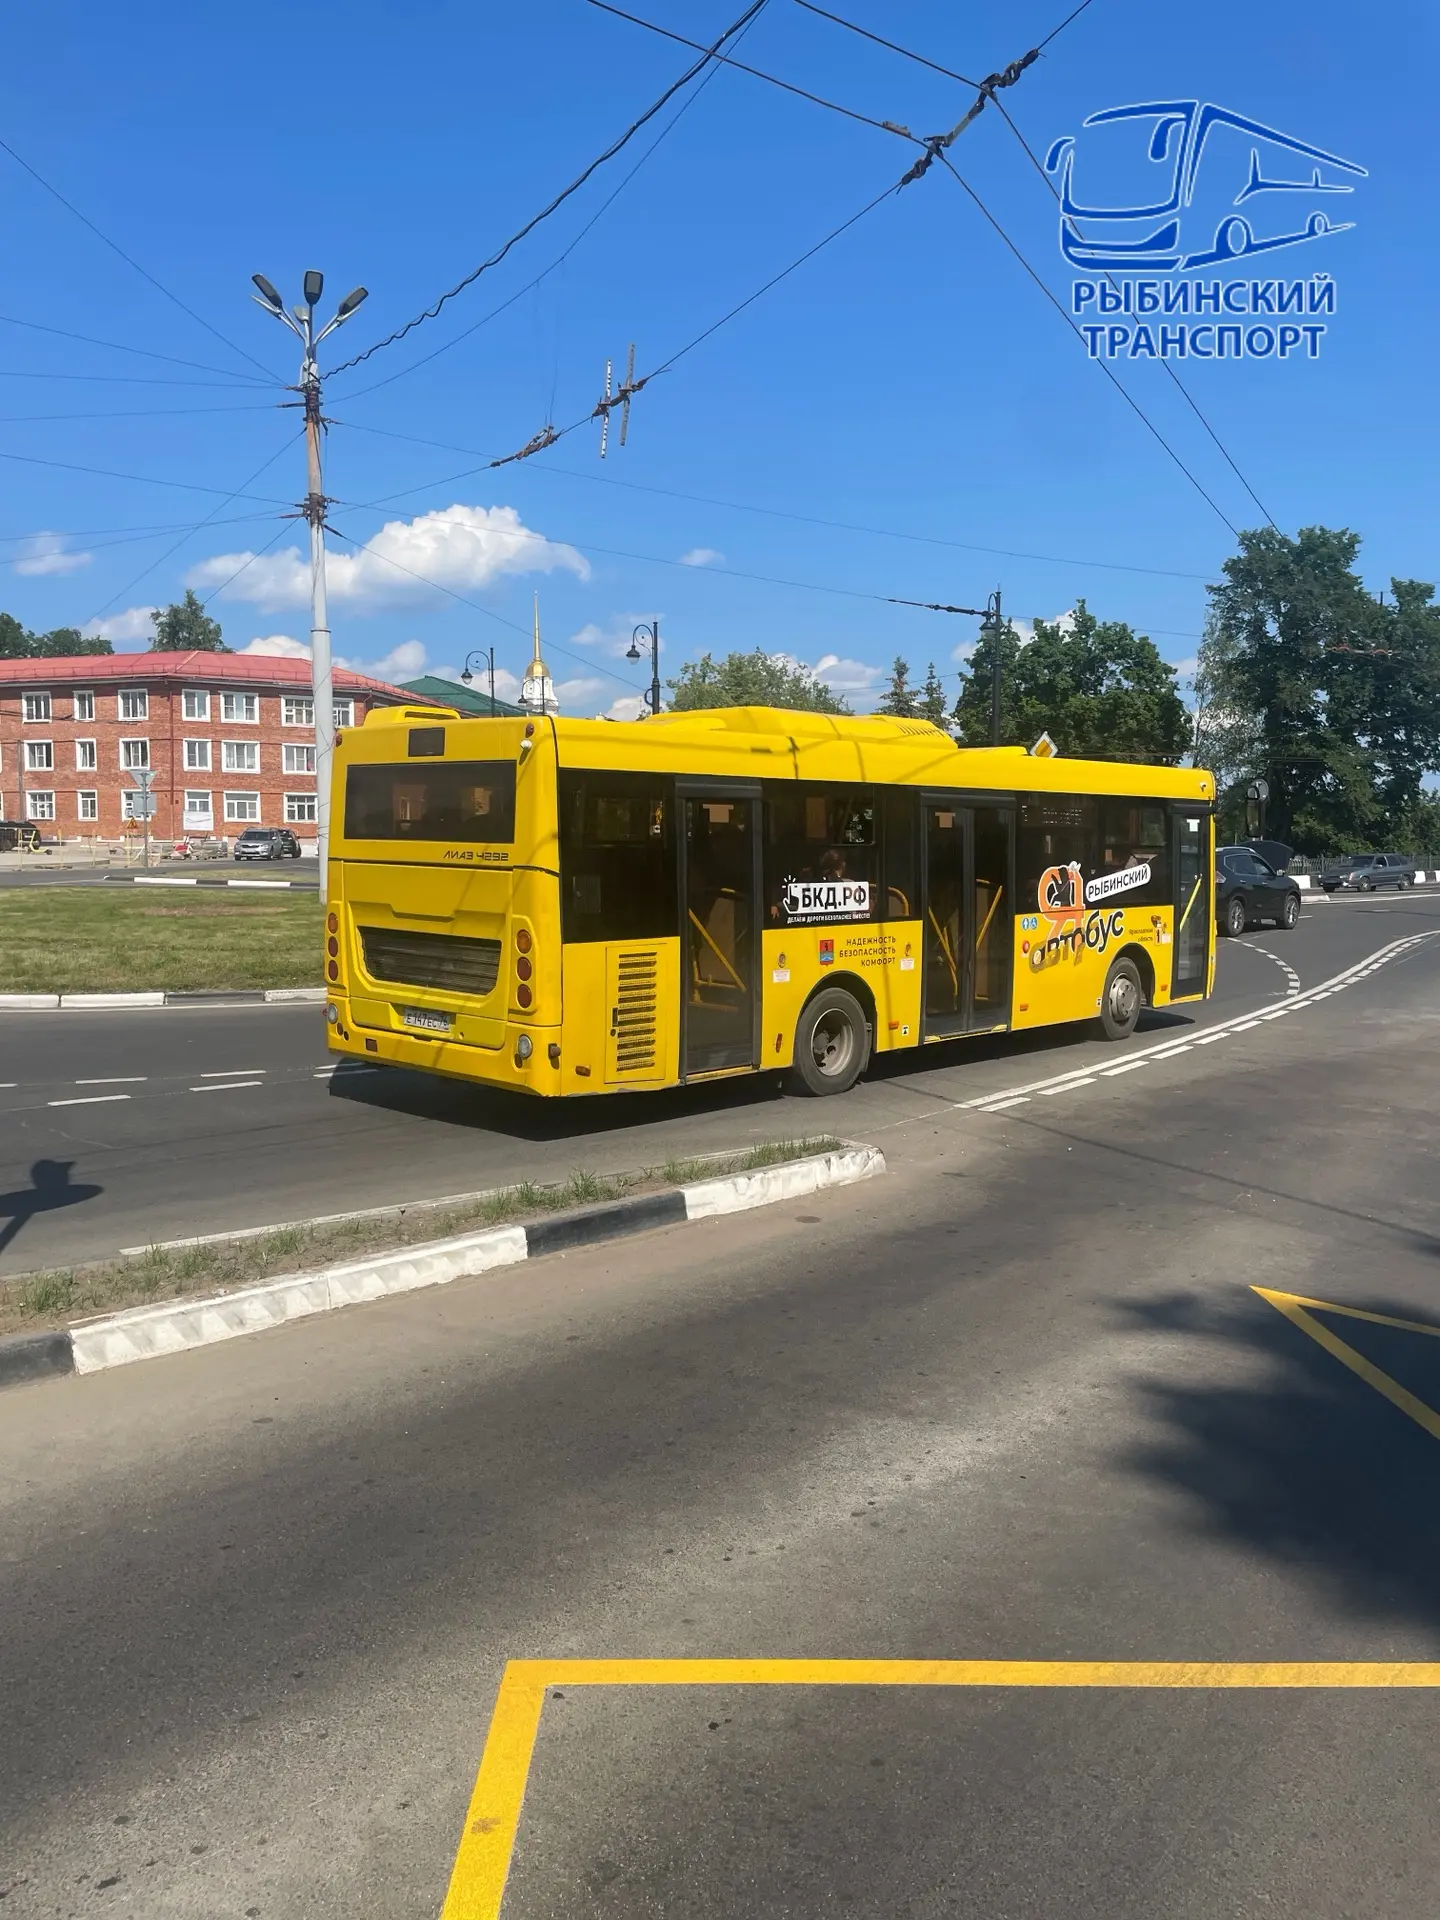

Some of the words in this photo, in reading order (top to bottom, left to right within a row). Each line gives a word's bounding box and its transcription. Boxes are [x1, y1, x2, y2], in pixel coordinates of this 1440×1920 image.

[1088, 865, 1148, 898] РЫБИНСКИЙ
[801, 886, 866, 909] БКД.РФ
[806, 915, 824, 923] ДОРОГИ
[846, 936, 896, 946] НАДЕЖНОСТЬ
[839, 947, 896, 958] БЕЗОПАСНОСТЬ
[861, 957, 896, 967] КОМФОРТ
